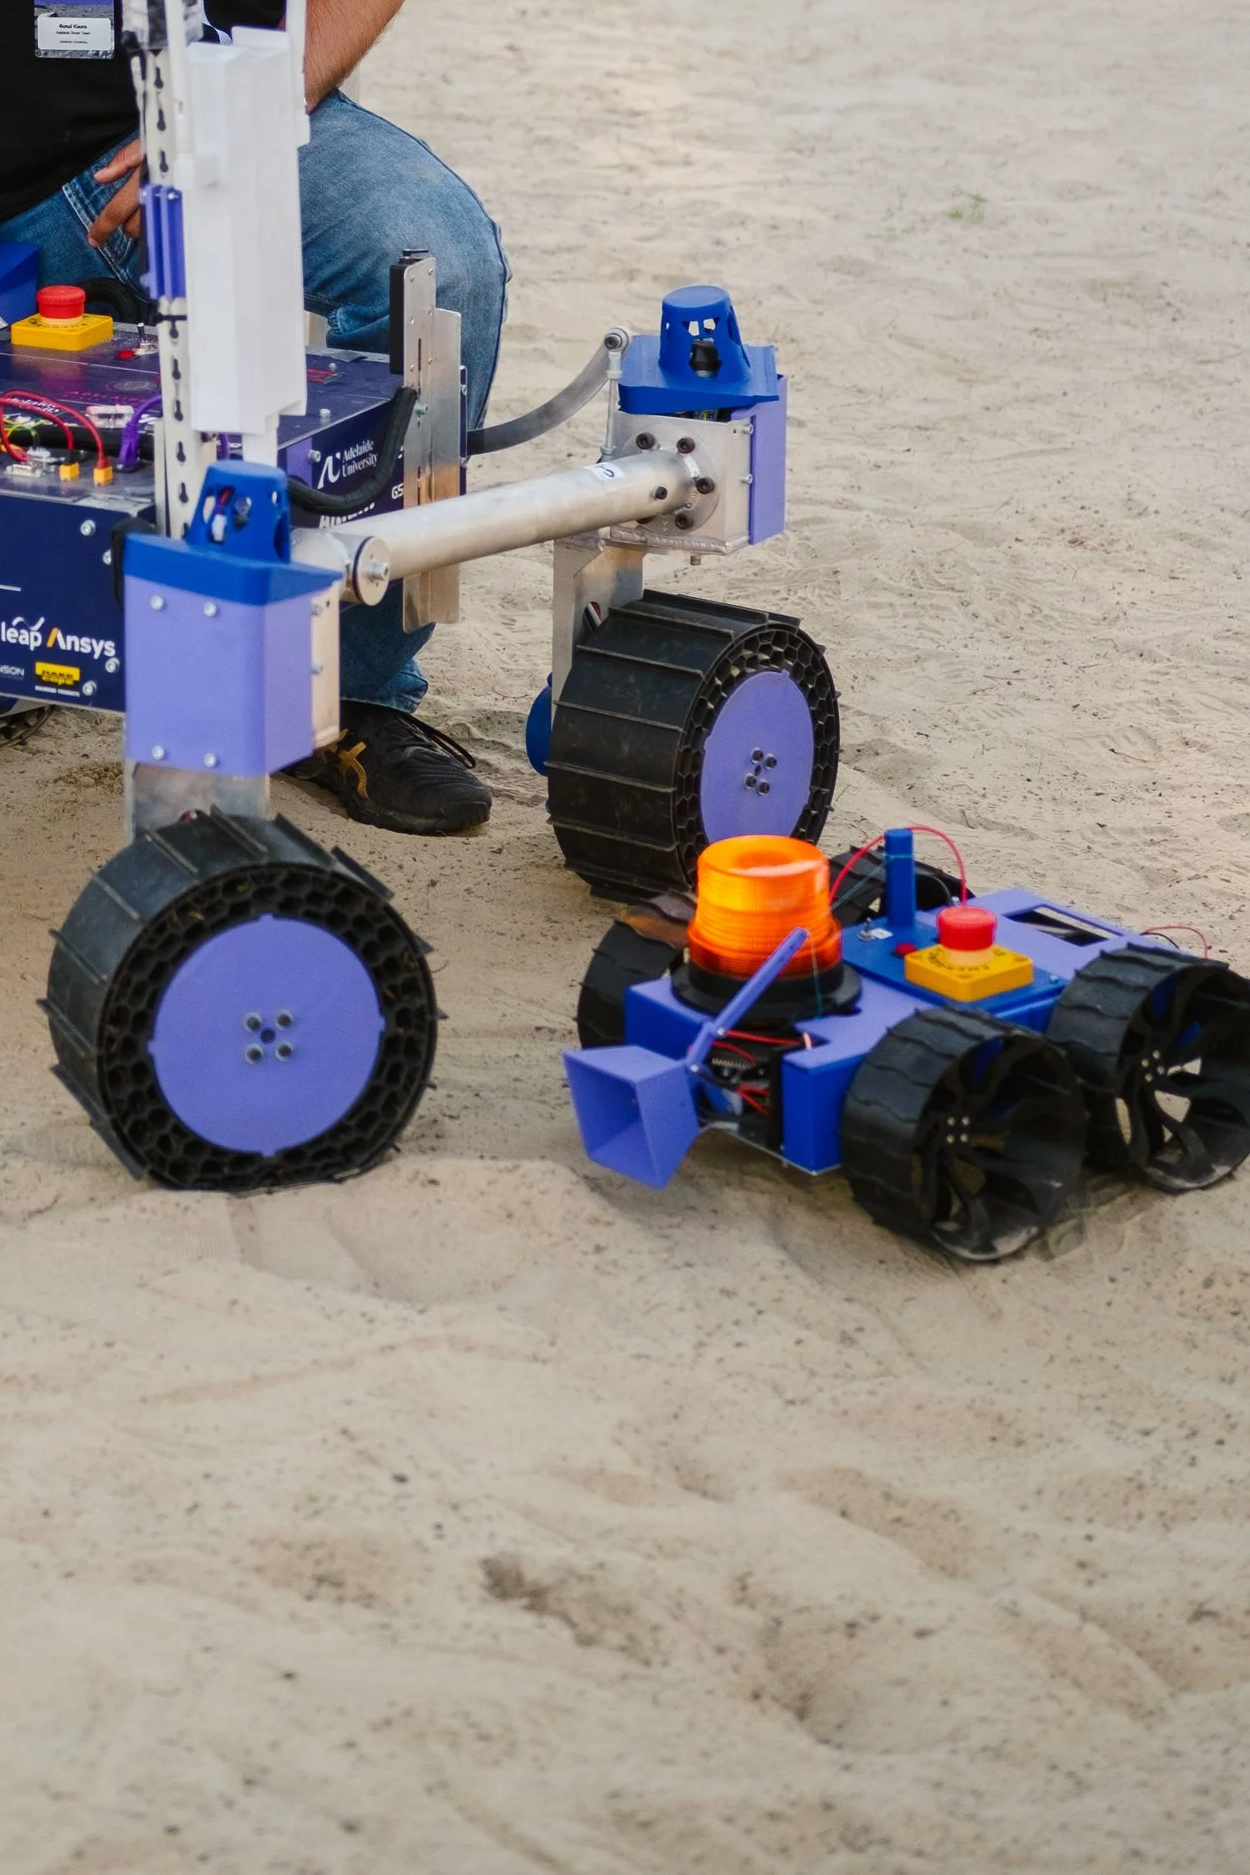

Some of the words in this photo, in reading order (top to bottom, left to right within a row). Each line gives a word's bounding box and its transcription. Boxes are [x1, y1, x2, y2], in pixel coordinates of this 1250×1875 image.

[343, 439, 375, 463] Adelaide
[342, 453, 378, 477] University
[1, 621, 42, 651] leap
[46, 627, 116, 660] Ansys
